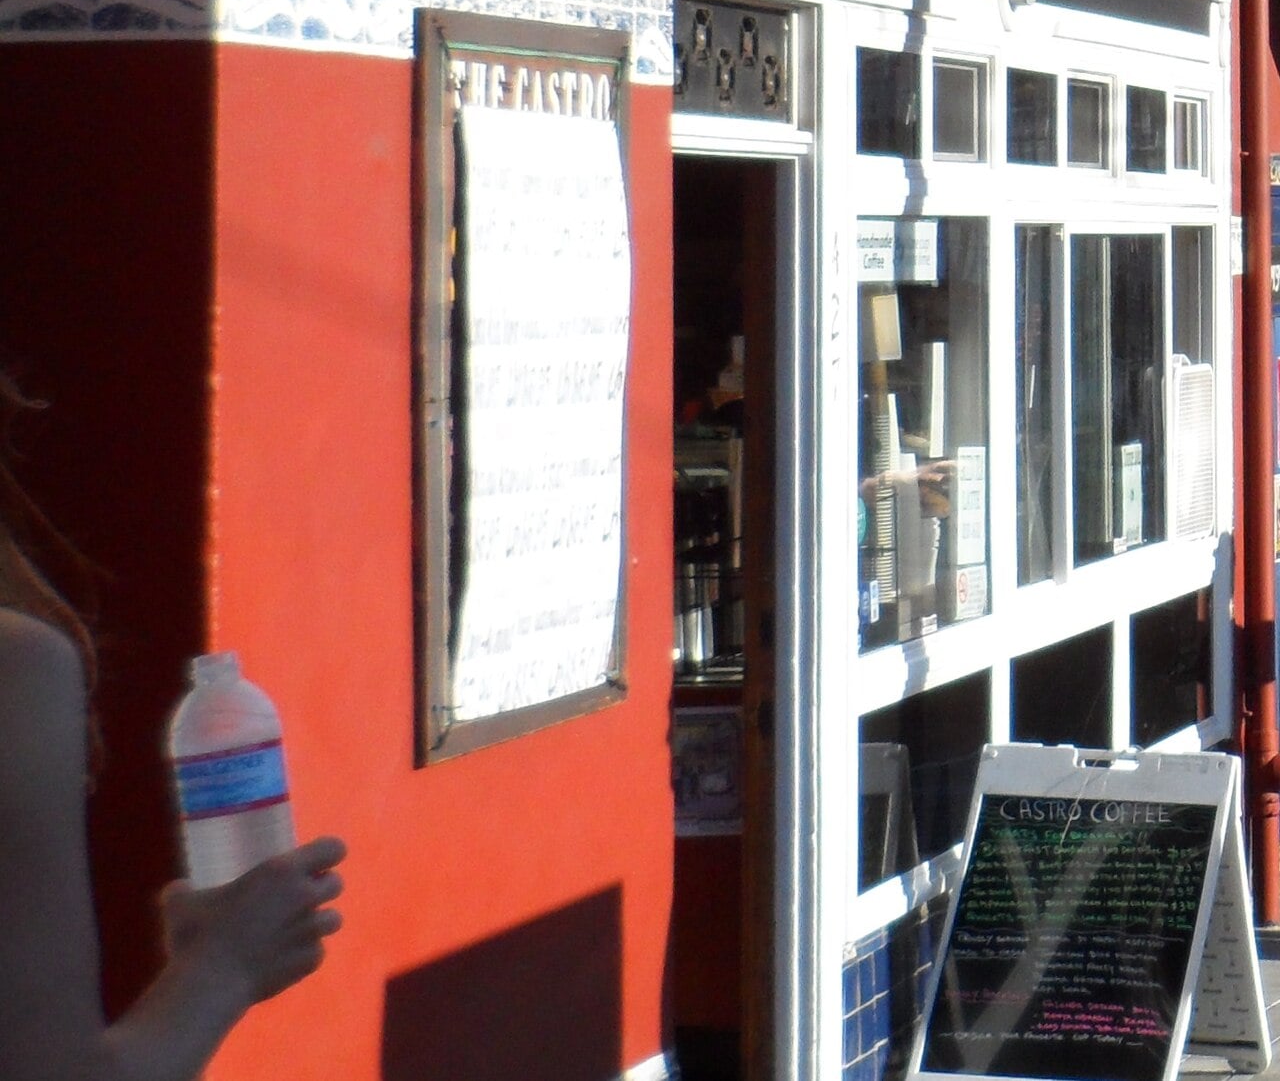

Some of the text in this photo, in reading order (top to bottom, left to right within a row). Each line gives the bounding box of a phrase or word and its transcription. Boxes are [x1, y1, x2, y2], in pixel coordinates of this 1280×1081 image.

[512, 67, 612, 121] CASTRO
[1000, 799, 1172, 824] CASTRO COFFEE
